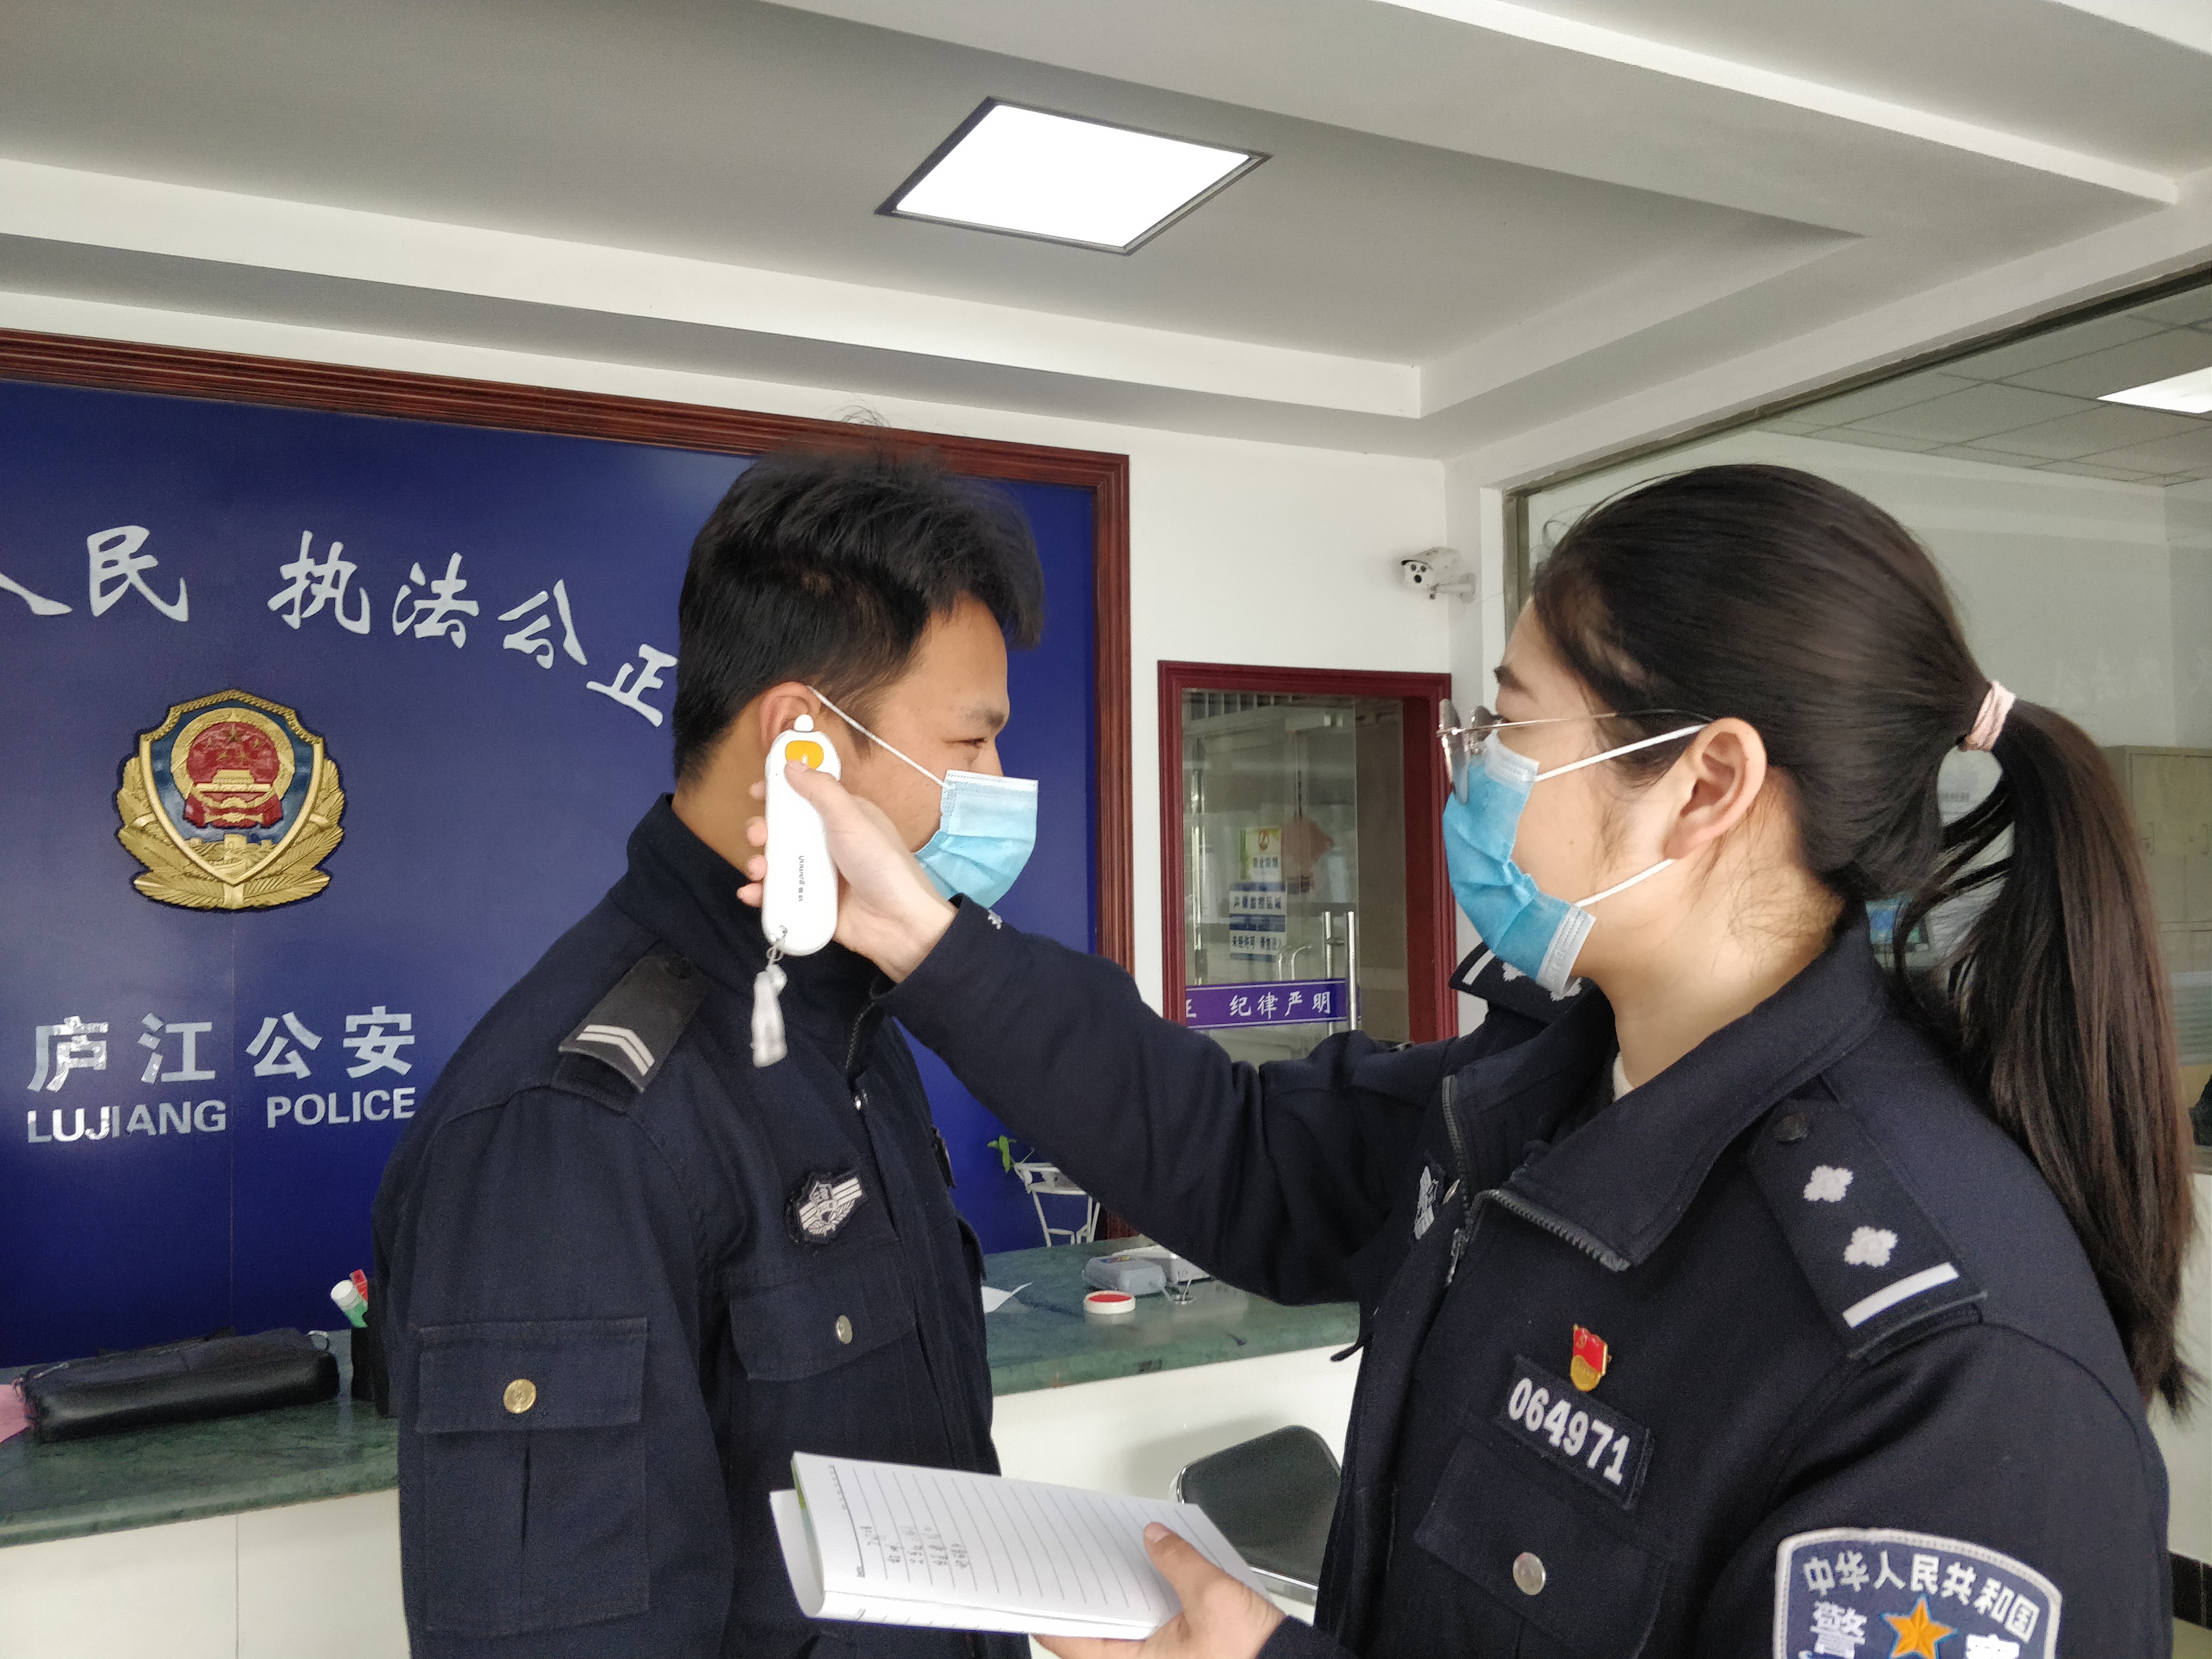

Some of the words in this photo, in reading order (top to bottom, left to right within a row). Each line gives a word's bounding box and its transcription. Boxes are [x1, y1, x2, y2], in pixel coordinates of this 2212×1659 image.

[268, 530, 678, 727] 执法公正
[1229, 991, 1331, 1020] 纪律严明
[27, 1006, 416, 1094] 庐江公安
[28, 1100, 226, 1143] LUJIANG
[268, 1087, 416, 1128] POLICE
[1509, 1377, 1630, 1484] 064971
[1803, 1550, 2041, 1643] 中华人民共和国
[1810, 1601, 1867, 1659] 警
